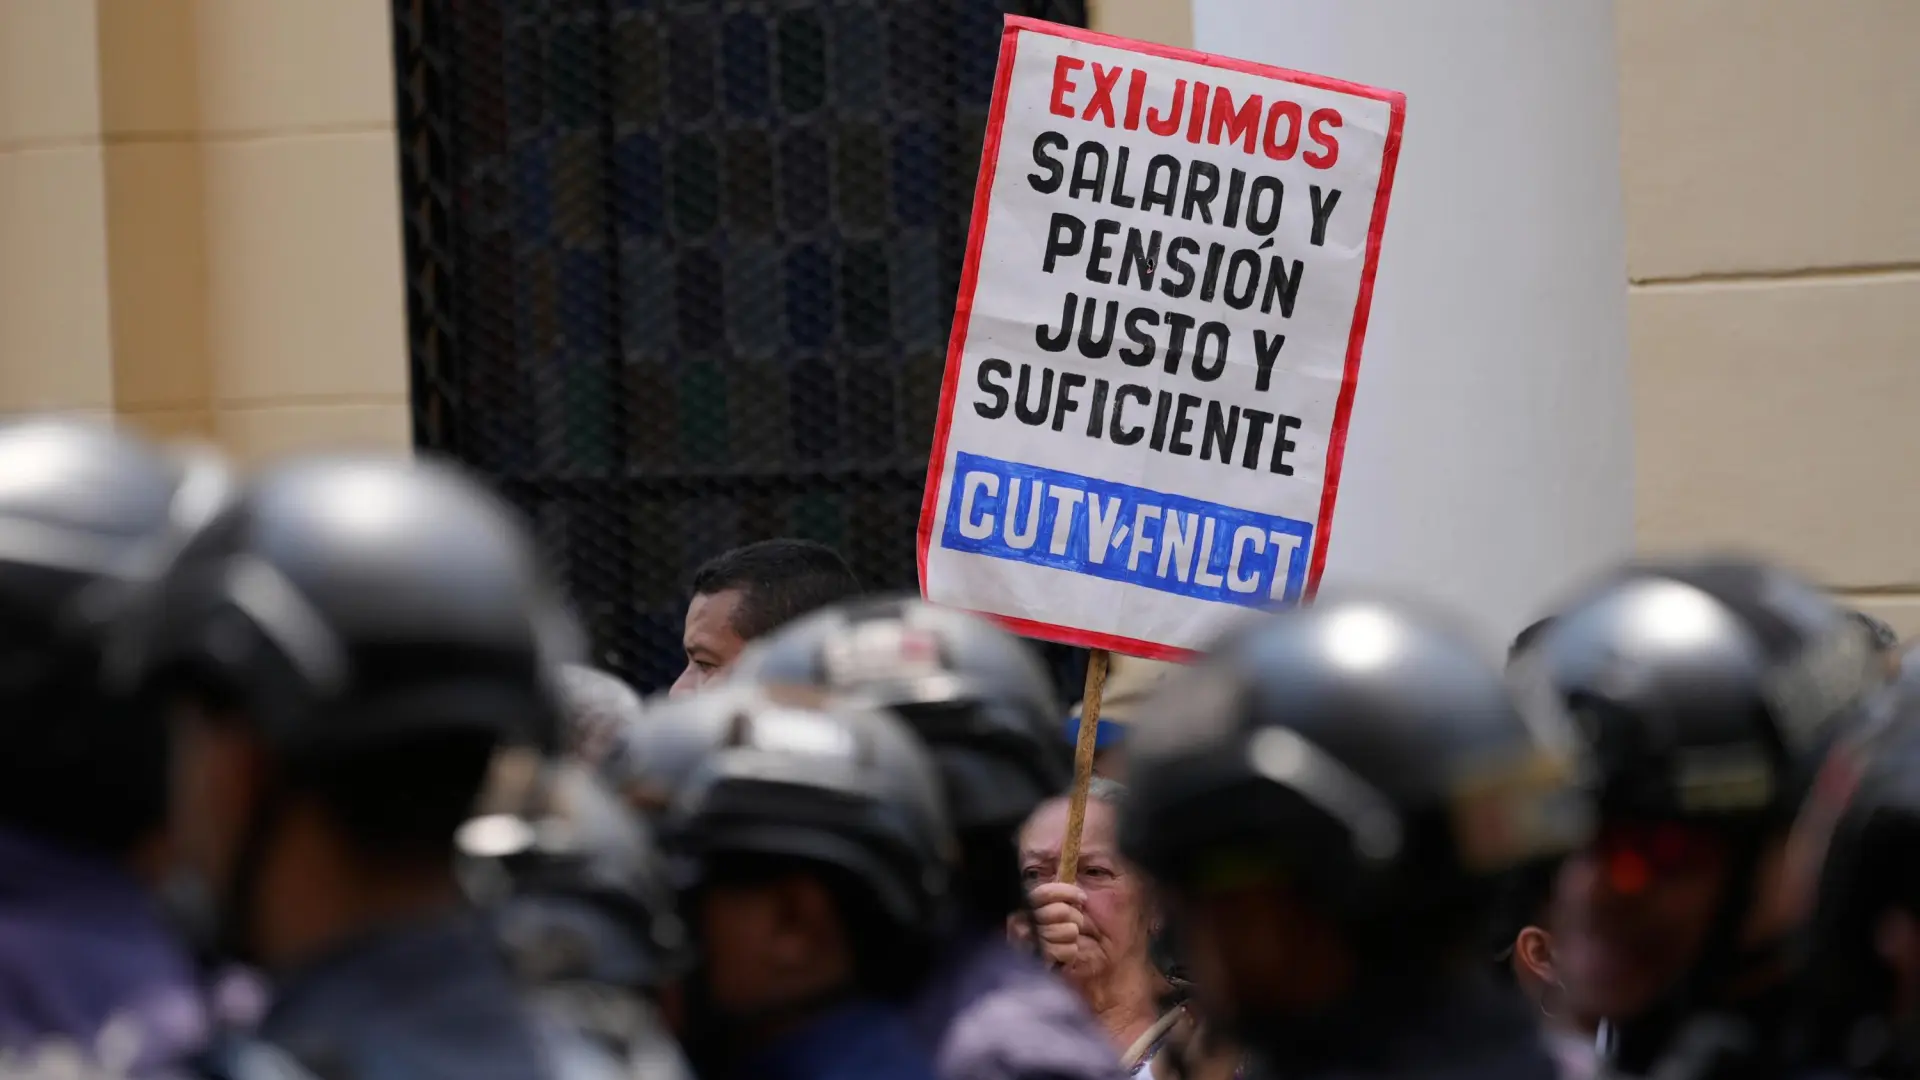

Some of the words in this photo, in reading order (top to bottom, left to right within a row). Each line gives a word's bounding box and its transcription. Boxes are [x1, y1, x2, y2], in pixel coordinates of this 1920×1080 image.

[1049, 55, 1343, 170] EXIJIMOS
[1027, 131, 1284, 236] SALARIO
[1308, 184, 1341, 247] Y
[1042, 212, 1304, 318] PENSIÓN
[1035, 292, 1230, 382] JUSTO
[1252, 329, 1285, 391] Y
[973, 358, 1302, 476] SUFICIENTE
[959, 471, 1302, 600] CUTV-FNLCT
